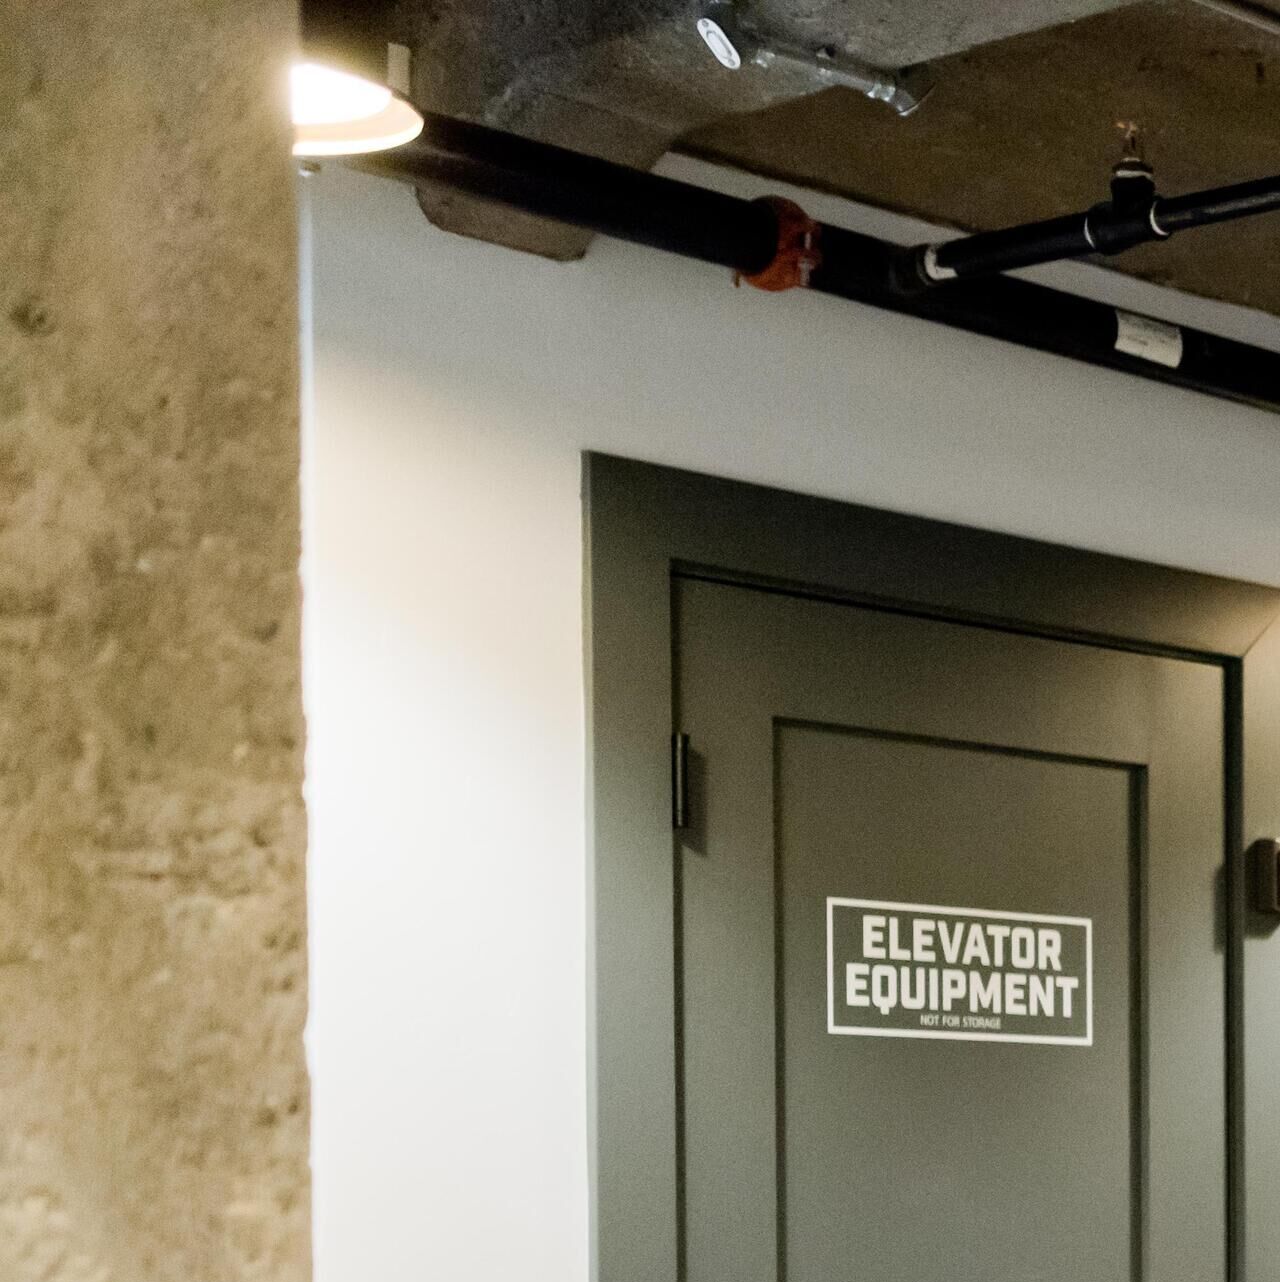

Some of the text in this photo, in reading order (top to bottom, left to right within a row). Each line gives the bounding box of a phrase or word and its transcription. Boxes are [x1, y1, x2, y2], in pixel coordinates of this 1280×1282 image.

[862, 914, 1062, 971] ELEVATOR
[846, 962, 1079, 1018] EQUIPMENT
[920, 1014, 1001, 1030] NOT FOR STORAGE
